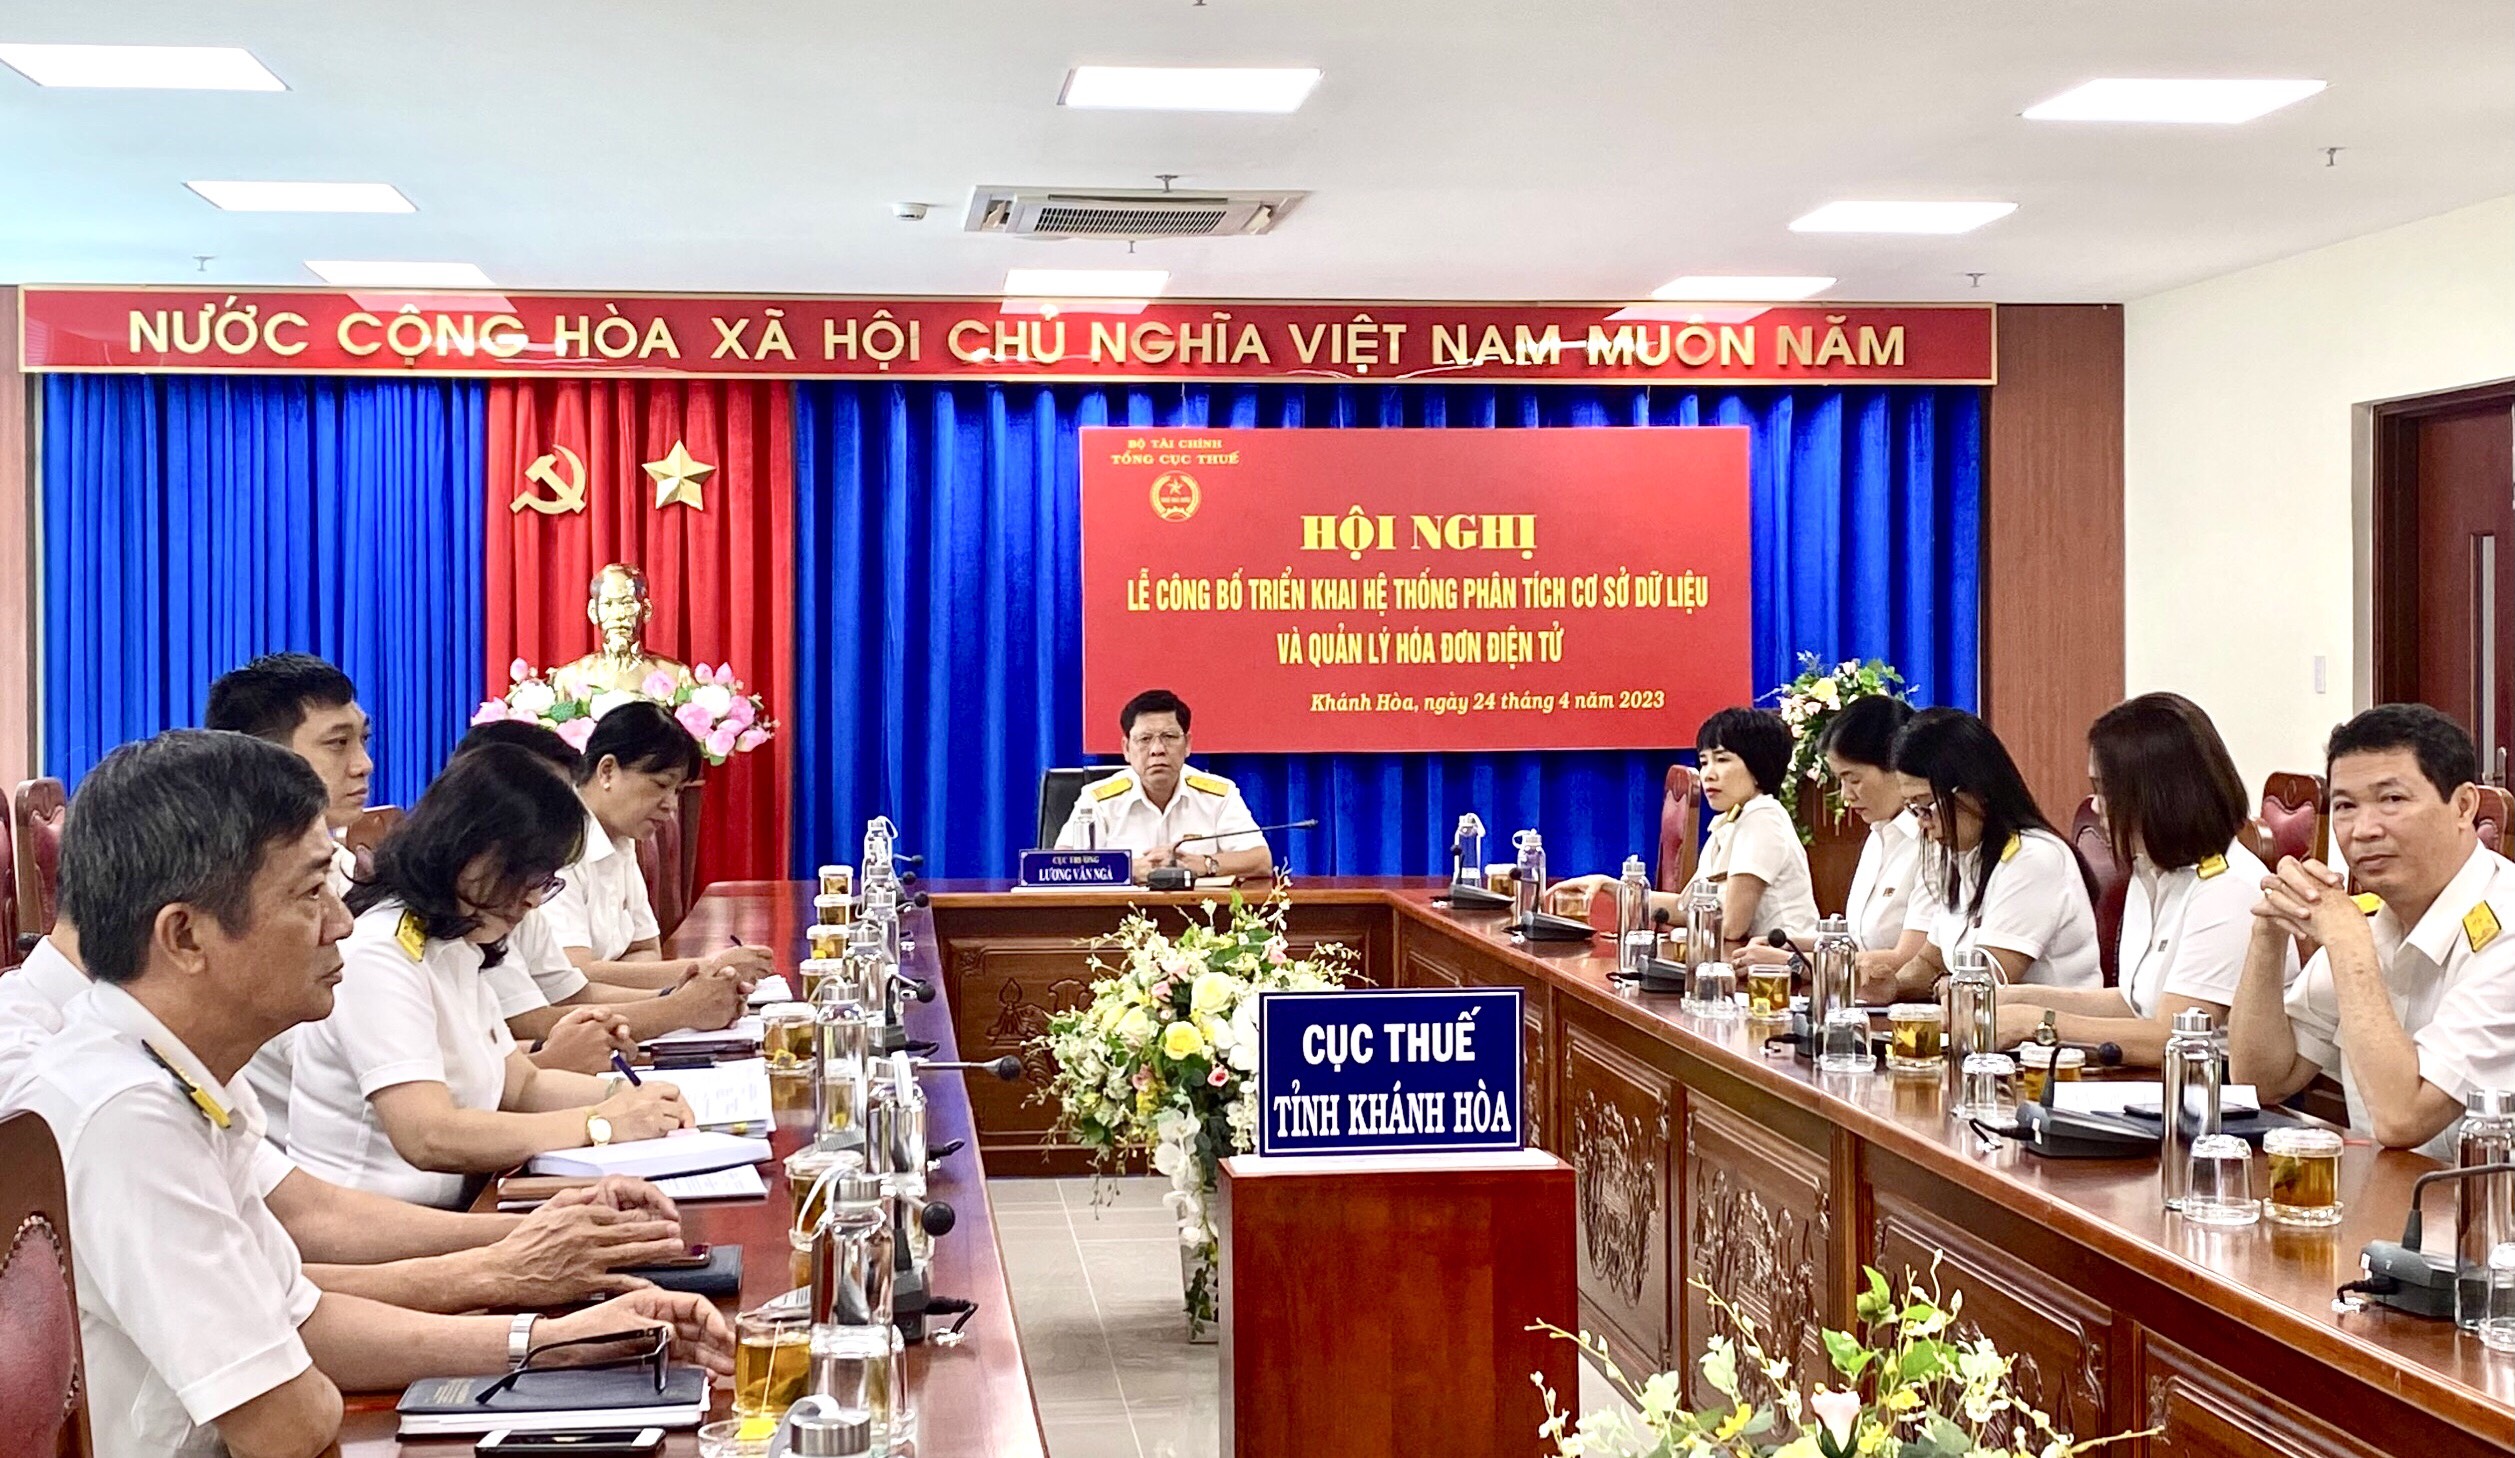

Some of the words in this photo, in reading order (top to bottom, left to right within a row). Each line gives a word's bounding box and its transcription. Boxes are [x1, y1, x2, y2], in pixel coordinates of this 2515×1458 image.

[129, 295, 309, 356] NƯỚC
[337, 304, 528, 367] CỘNG
[556, 304, 681, 359] HÒA
[710, 308, 796, 361] XÃ
[824, 309, 921, 371] HỘI
[948, 303, 1067, 364] CHỦ
[1091, 311, 1270, 364] NGHĨA
[1288, 315, 1406, 373] VIỆT
[1432, 324, 1561, 366] NAM
[1588, 314, 1755, 366] MUÔN
[1776, 316, 1904, 366] NĂM
[1128, 438, 1145, 450] BỘ
[1151, 437, 1174, 449] TÀI
[1178, 438, 1222, 449] CHÍNH
[1159, 454, 1191, 466] CỤC
[1197, 451, 1240, 464] THUẾ
[1300, 504, 1397, 561] HỘI
[1410, 513, 1537, 560] NGHỊ
[1127, 568, 1150, 611] LỄ
[1156, 572, 1210, 611] CÔNG
[1216, 567, 1243, 610] BỐ
[1248, 566, 1305, 610] TRIỂN
[1311, 578, 1357, 610] KHAI
[1363, 571, 1388, 617] HỆ
[1393, 567, 1458, 610] THỐNG
[1463, 571, 1517, 609] PHÂN
[1522, 570, 1566, 608] TÍCH
[1571, 573, 1598, 608] CƠ
[1603, 566, 1630, 607] SỞ
[1635, 571, 1664, 607] DỮ
[1667, 570, 1708, 614] LIỆU
[1276, 625, 1303, 664] VÀ
[1308, 622, 1362, 668] QUẢN
[1368, 625, 1391, 664] LÝ
[1396, 625, 1436, 664] HÓA
[1440, 629, 1481, 663] ĐƠN
[1486, 624, 1532, 670] ĐIỆN
[1538, 620, 1564, 662] TỬ
[1310, 691, 1372, 711] Khánh
[1375, 692, 1419, 713] Hòa,
[1423, 691, 1469, 716] ngày
[1473, 692, 1496, 710] 24
[1500, 691, 1554, 714] tháng
[1558, 692, 1570, 710] 4
[1574, 692, 1615, 710] năm
[1619, 690, 1666, 709] 2023
[1302, 1023, 1374, 1072] CỤC
[1384, 1006, 1481, 1062] THUẾ
[1273, 1079, 1340, 1137] TỈNH
[1348, 1080, 1446, 1135] KHÁNH
[1453, 1078, 1512, 1133] HÒA
